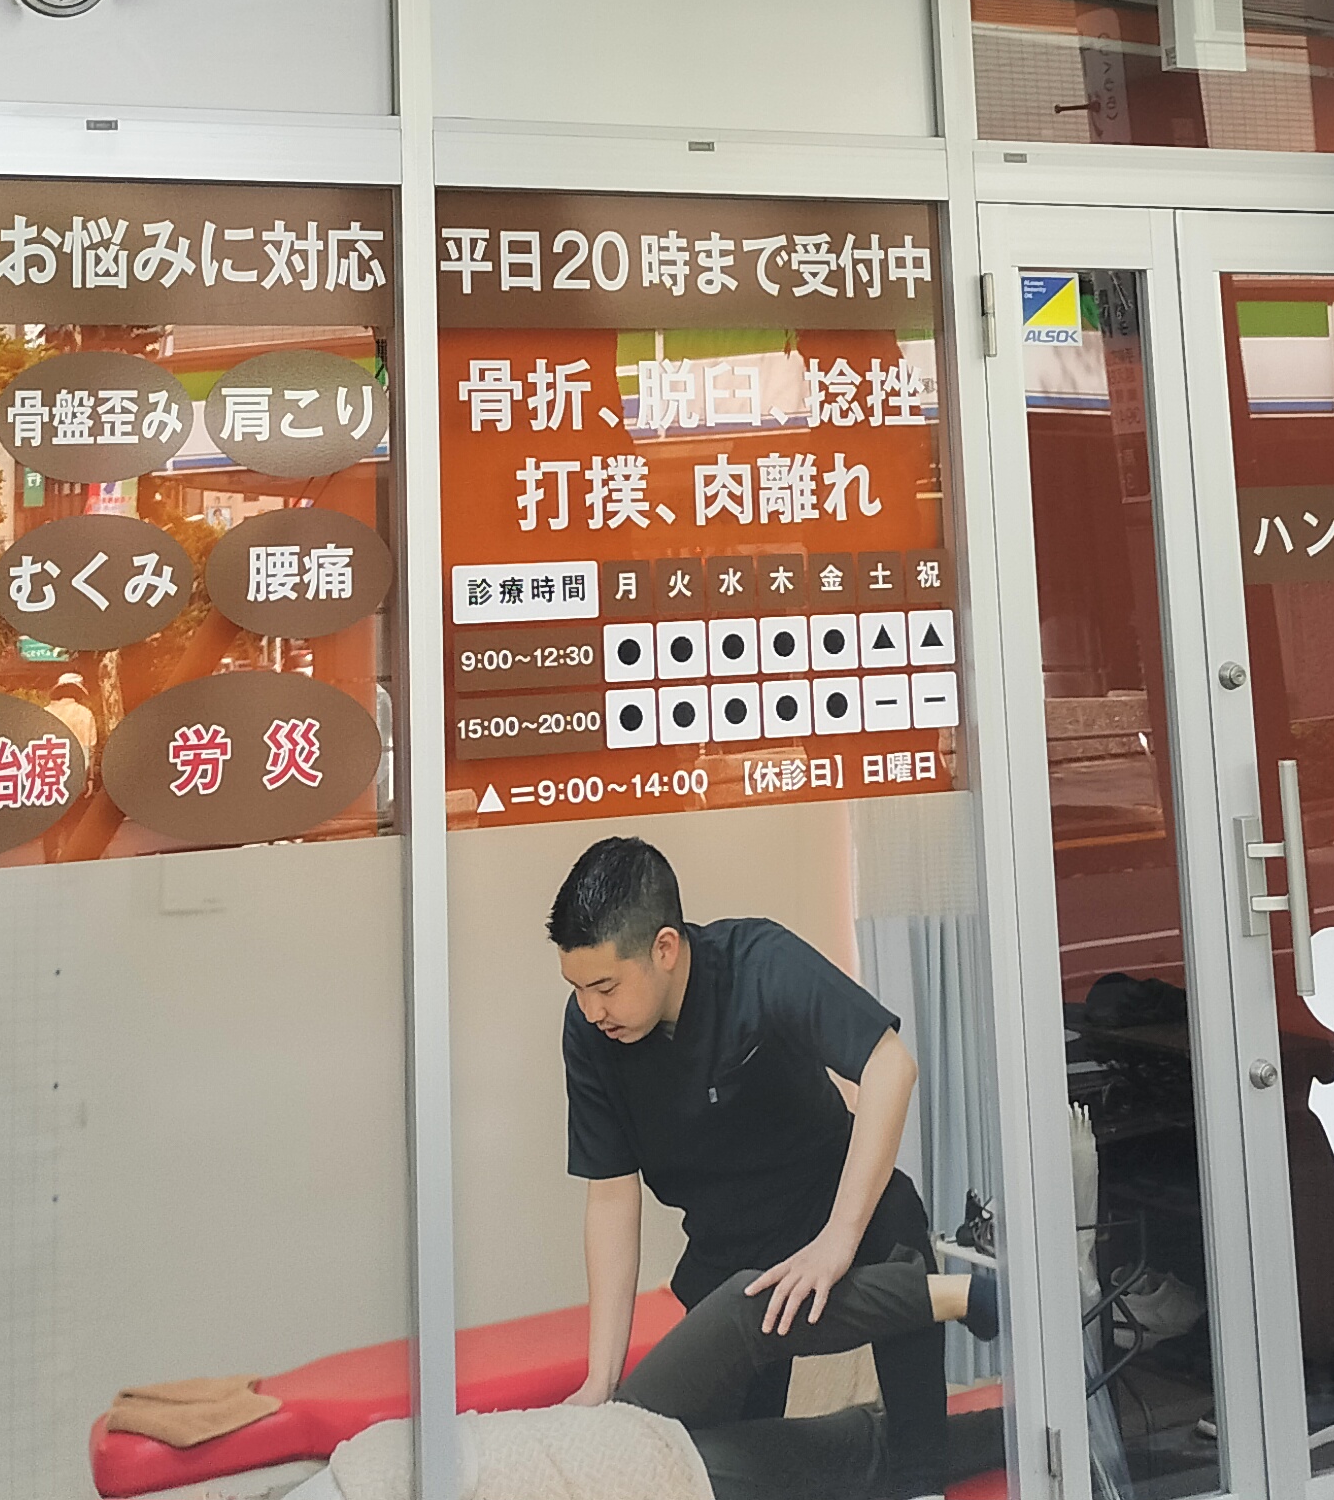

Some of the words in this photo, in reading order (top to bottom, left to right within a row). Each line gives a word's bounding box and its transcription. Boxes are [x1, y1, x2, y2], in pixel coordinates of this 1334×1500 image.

[1024, 329, 1080, 344] ALSOK
[7, 389, 183, 447] 骨盤歪み
[219, 385, 375, 443] 肩こり
[458, 357, 927, 432] 骨折、脱臼、捻挫
[516, 452, 883, 531] 打撲、肉離れ
[9, 552, 178, 611] むくみ
[247, 544, 355, 602] 腰痛
[467, 574, 587, 606] 診療時間
[614, 572, 638, 599] 月
[668, 570, 693, 598] 火
[718, 567, 744, 595] 水
[769, 566, 794, 594] 木
[819, 564, 844, 592] 金
[869, 564, 893, 589] 土
[917, 561, 942, 588] 祝
[862, 751, 938, 785] 日曜日
